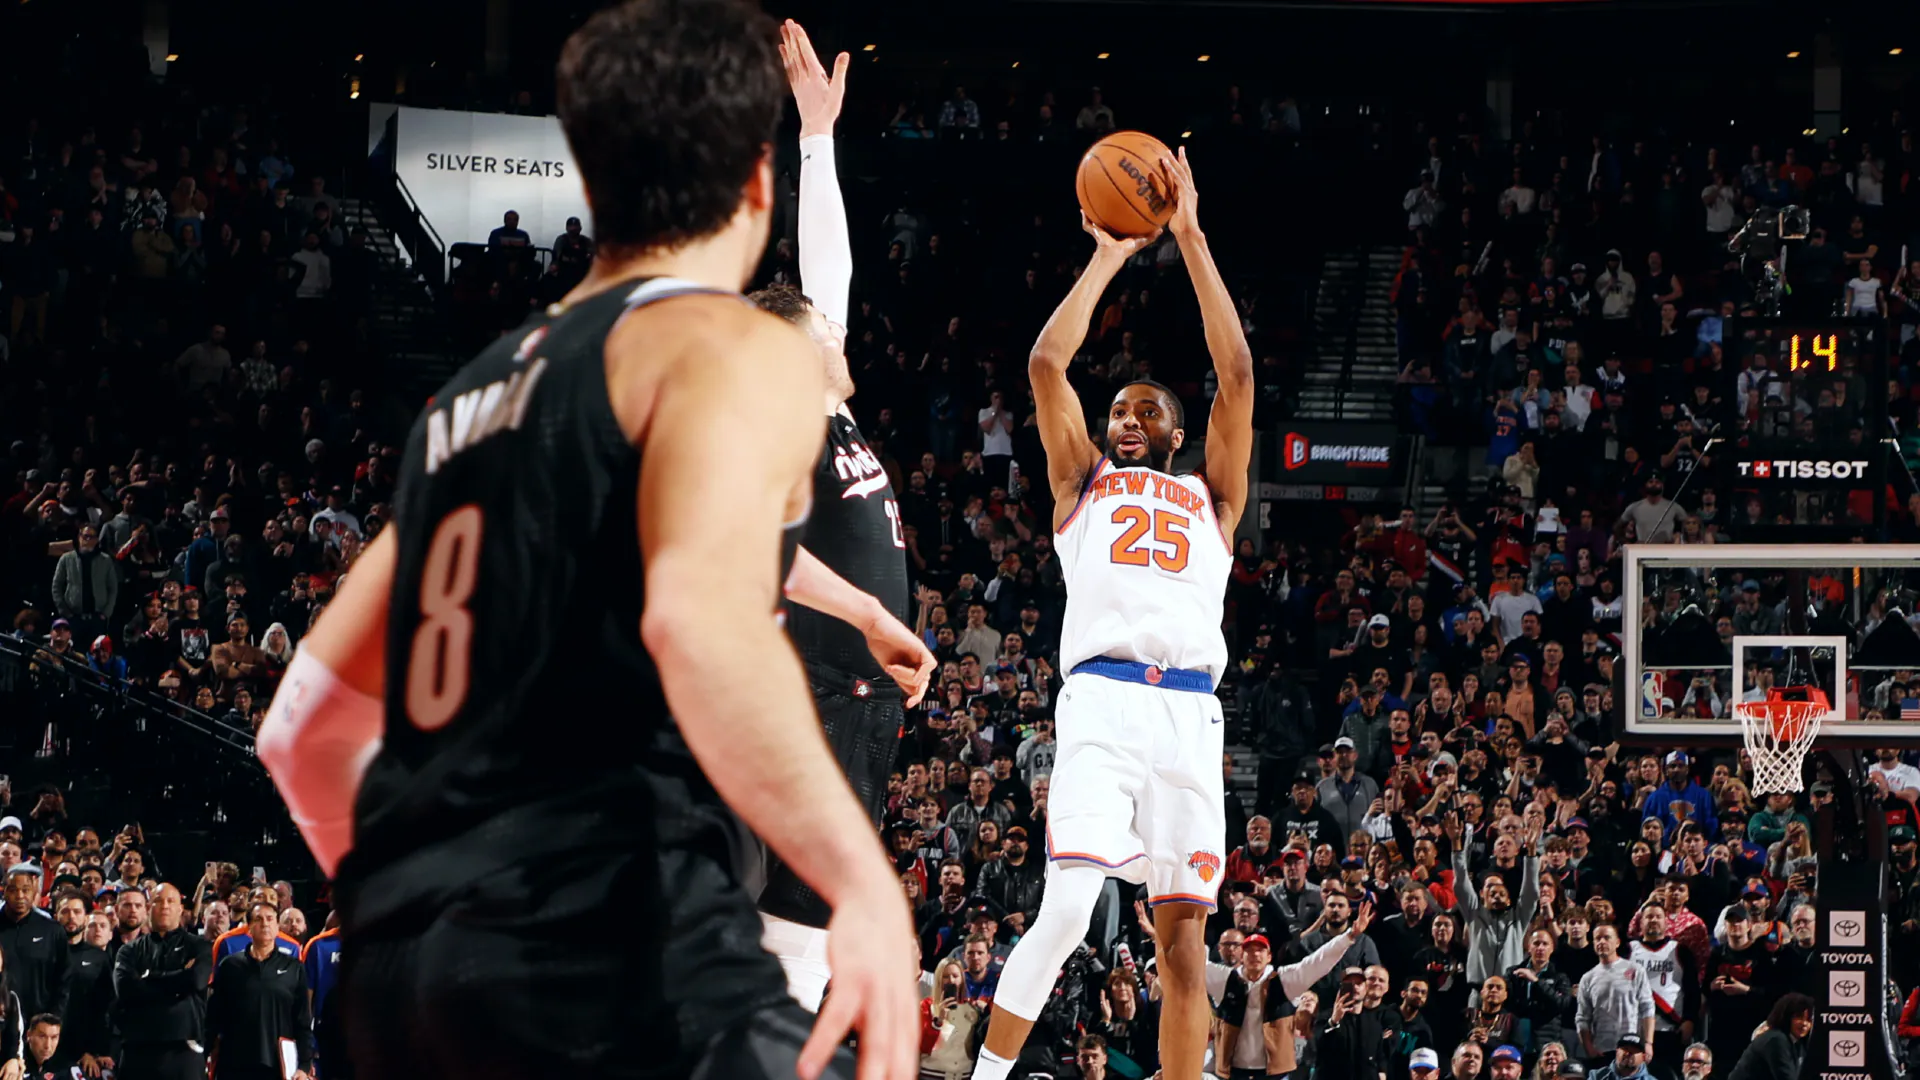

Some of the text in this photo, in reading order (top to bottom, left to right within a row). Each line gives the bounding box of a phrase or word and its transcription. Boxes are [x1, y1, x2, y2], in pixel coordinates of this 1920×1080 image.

[427, 153, 564, 178] SILVER SEATS
[1790, 334, 1837, 371] 1.4
[1292, 439, 1305, 463] B
[1310, 444, 1390, 462] BRIGHTSIDE
[1773, 460, 1868, 478] TISSOT
[1092, 471, 1206, 524] NEW YORK
[1110, 504, 1190, 573] 25
[405, 503, 484, 732] 8
[1820, 953, 1874, 964] TOYOTA
[1820, 1013, 1874, 1024] TOYOTA
